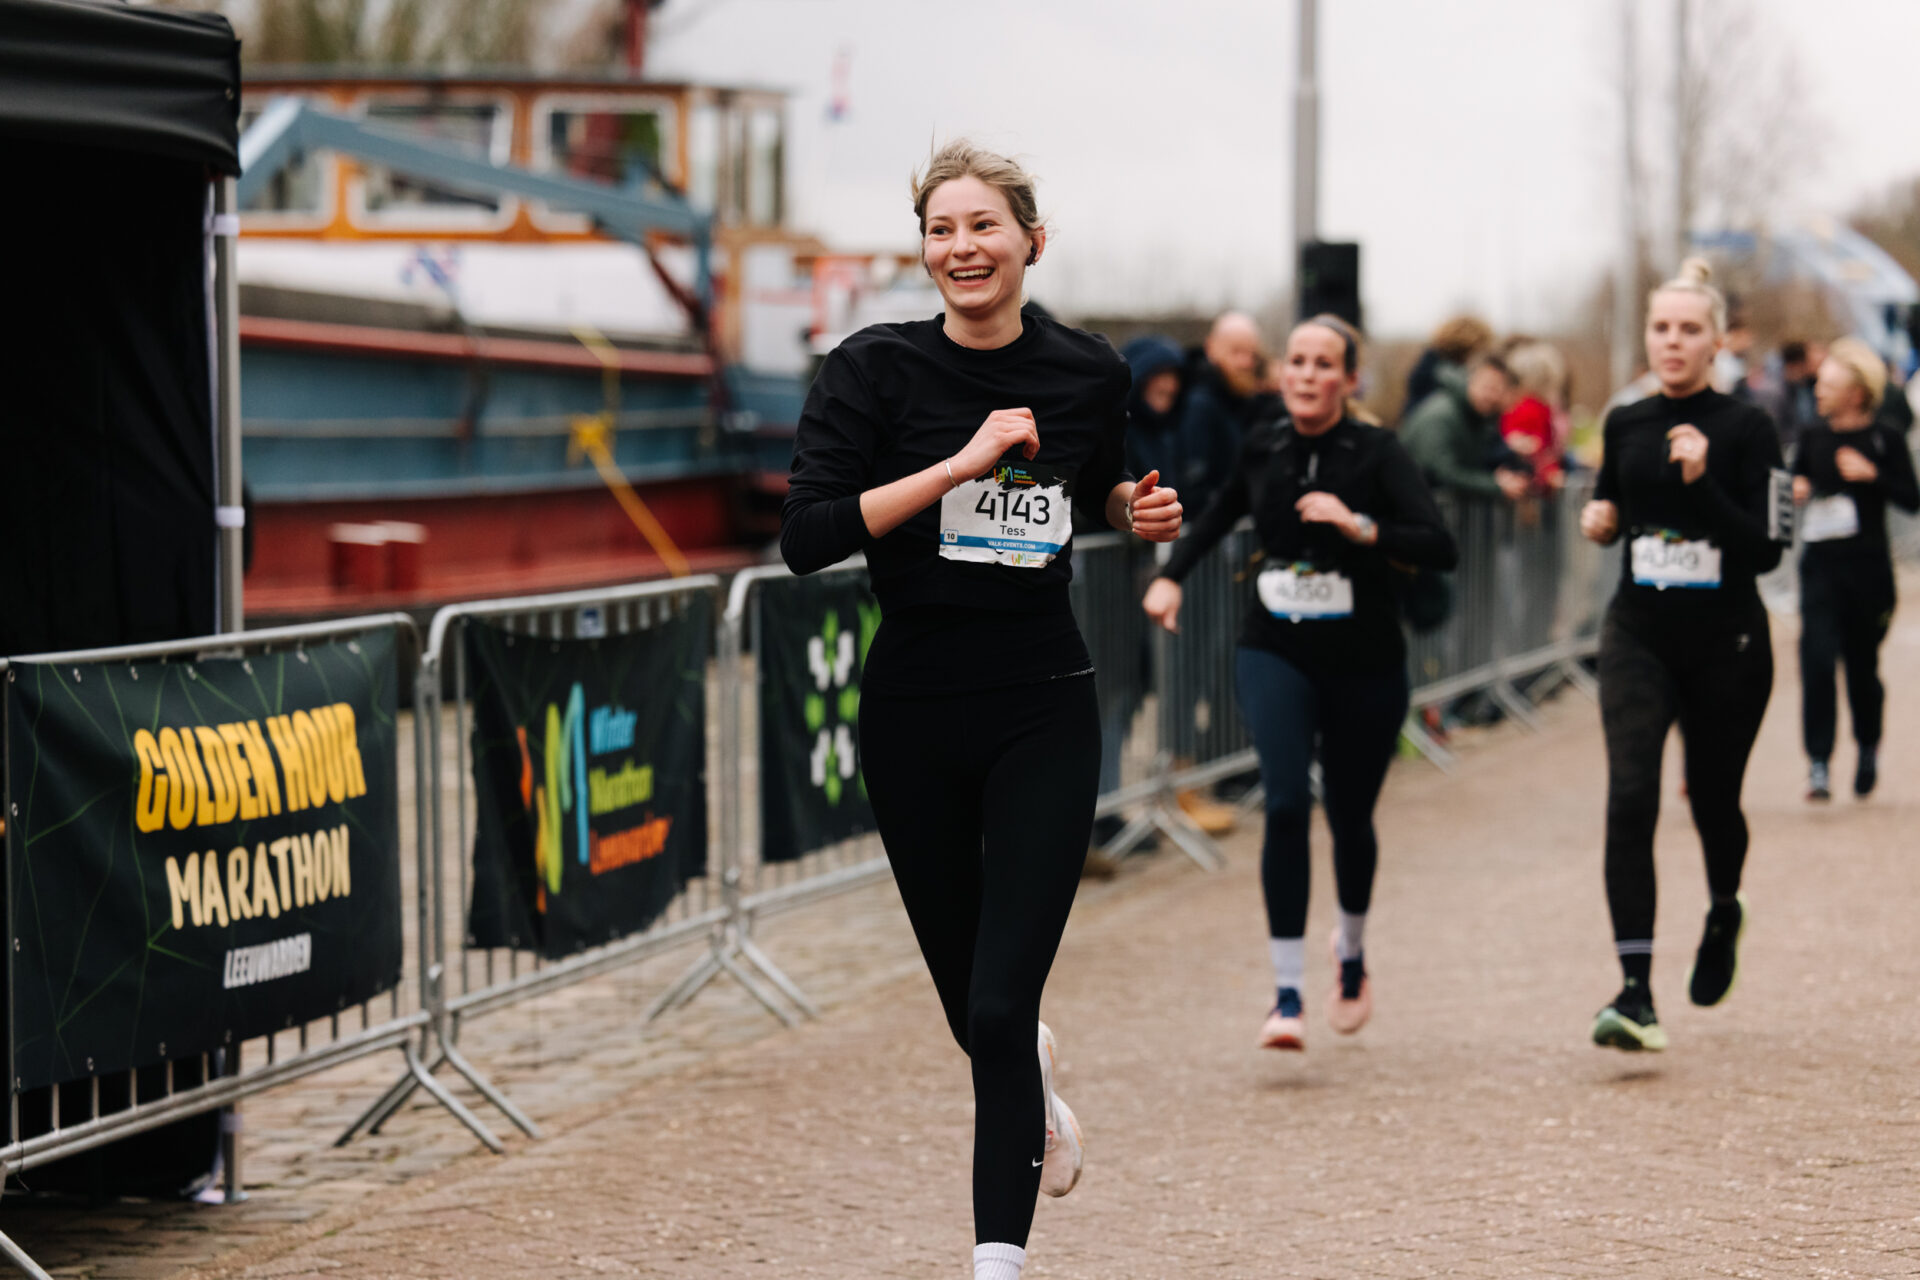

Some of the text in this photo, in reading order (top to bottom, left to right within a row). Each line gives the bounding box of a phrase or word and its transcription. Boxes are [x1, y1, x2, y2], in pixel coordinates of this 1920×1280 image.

[975, 491, 1050, 525] 4143
[1000, 525, 1026, 537] Tess
[134, 702, 367, 833] GOLDEN HOUR
[165, 824, 351, 930] MARATHON
[224, 932, 312, 989] LEEUWARDEN
